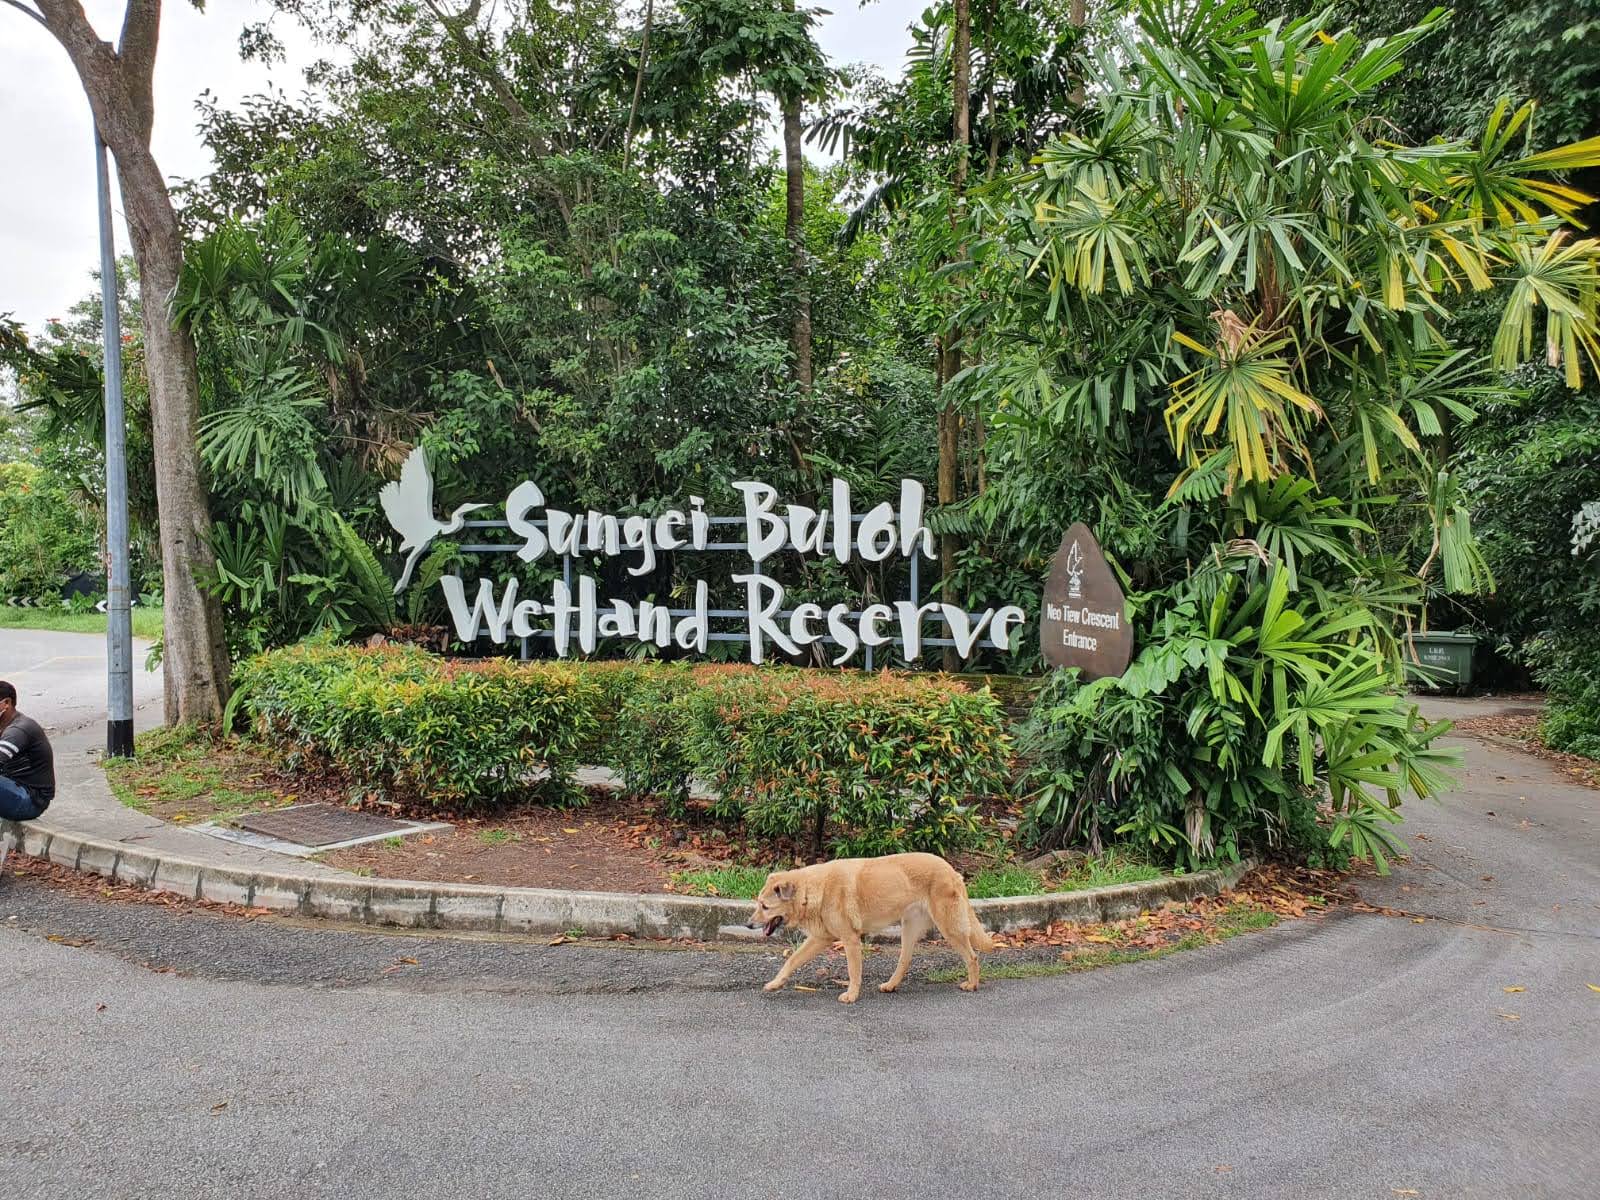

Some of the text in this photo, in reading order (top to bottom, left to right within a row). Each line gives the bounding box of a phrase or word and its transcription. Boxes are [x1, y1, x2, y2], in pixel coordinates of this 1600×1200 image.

[506, 478, 938, 576] Sungei Buloh
[439, 574, 1026, 665] Wetland Reserve
[1047, 603, 1119, 630] Neo Tiew Crescent
[1063, 629, 1097, 651] Entrance
